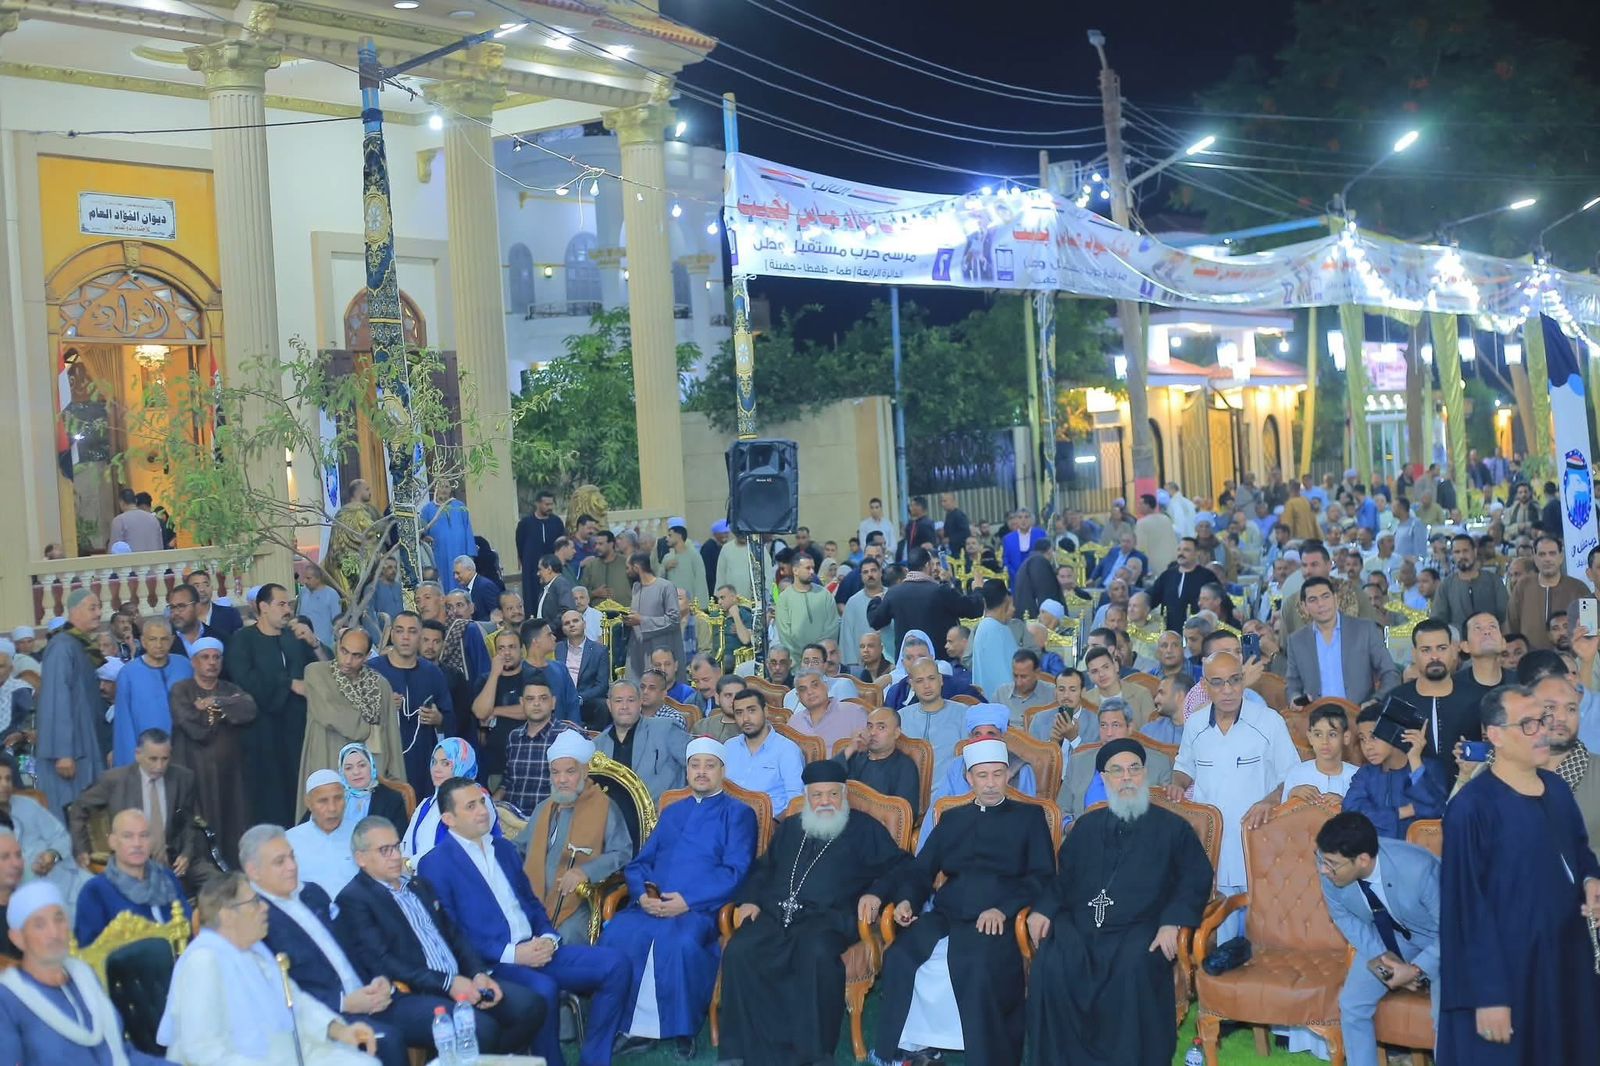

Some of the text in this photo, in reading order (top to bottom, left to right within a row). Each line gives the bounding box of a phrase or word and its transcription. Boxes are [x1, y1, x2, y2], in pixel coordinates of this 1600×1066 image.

[88, 206, 167, 226] ديوان الفؤاد العام
[737, 193, 790, 226] بخيت
